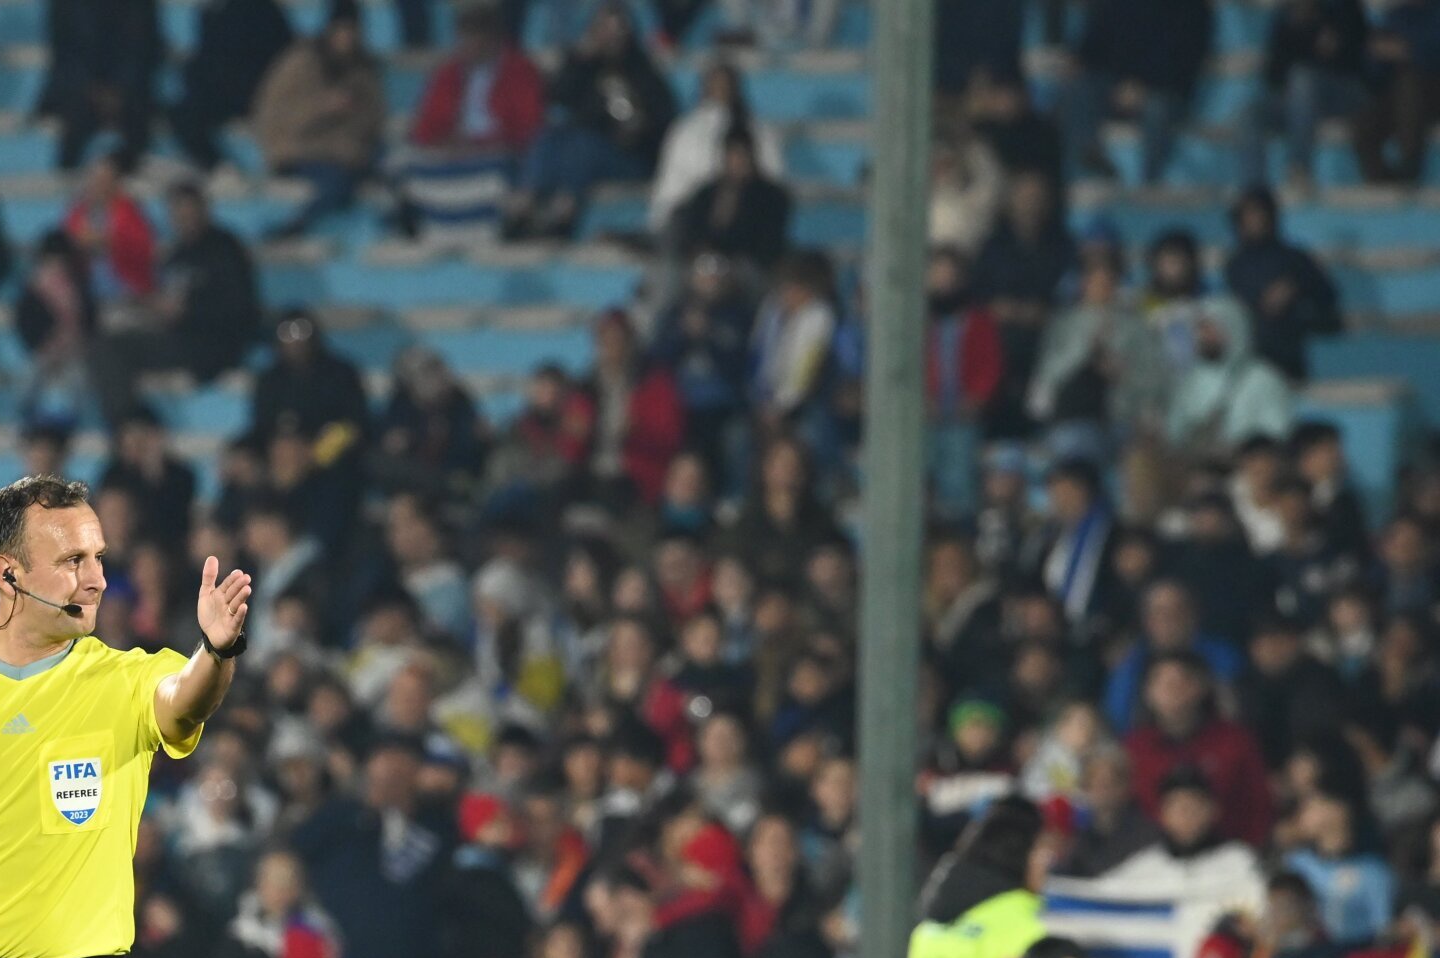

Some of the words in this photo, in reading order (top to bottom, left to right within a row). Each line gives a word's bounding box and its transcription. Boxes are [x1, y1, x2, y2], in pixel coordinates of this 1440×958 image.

[53, 762, 97, 781] FIFA
[56, 788, 98, 800] REFEREE
[69, 810, 89, 820] 2023
